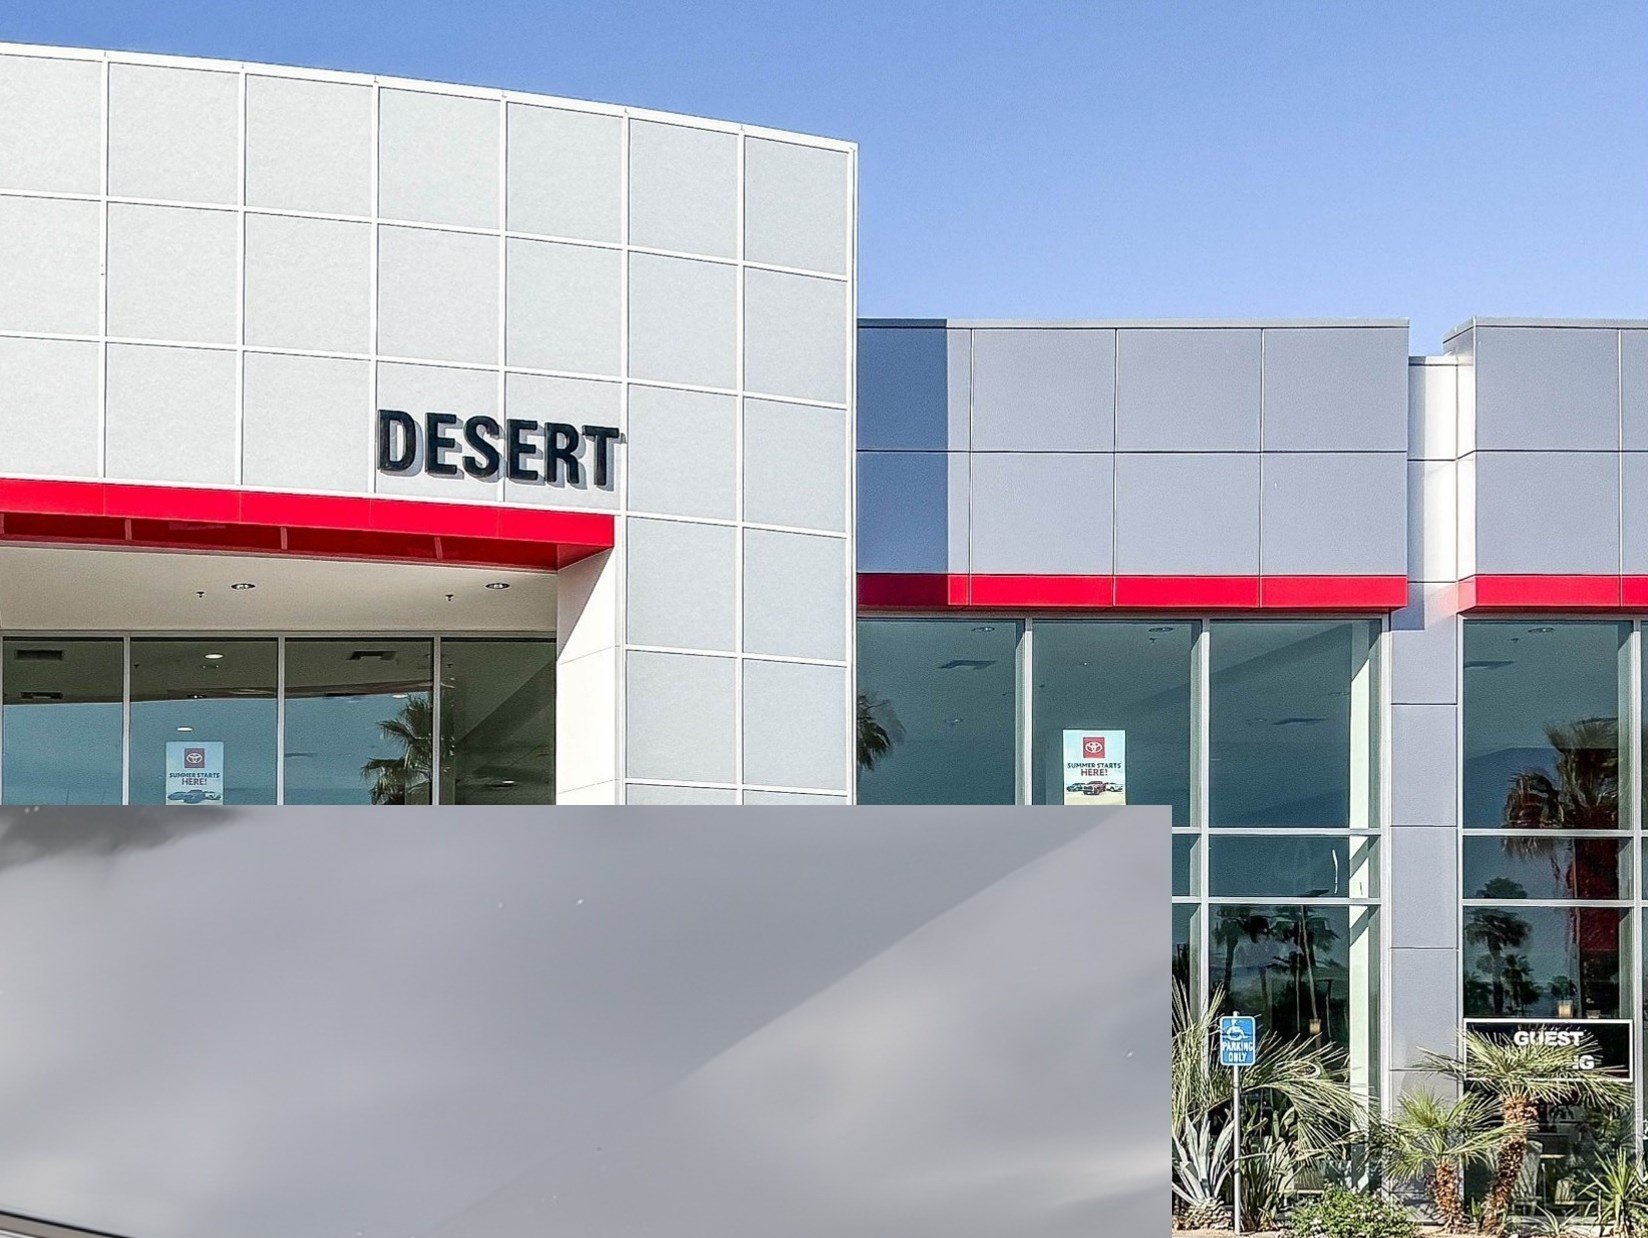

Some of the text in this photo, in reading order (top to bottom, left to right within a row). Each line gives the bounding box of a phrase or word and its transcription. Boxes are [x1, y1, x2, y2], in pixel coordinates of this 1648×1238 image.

[377, 409, 620, 486] DESERT
[1081, 768, 1108, 777] HERE!
[181, 777, 207, 786] HERE!
[1513, 1030, 1584, 1047] GUEST
[1222, 1041, 1254, 1052] PARKING
[1228, 1051, 1248, 1063] ONLY
